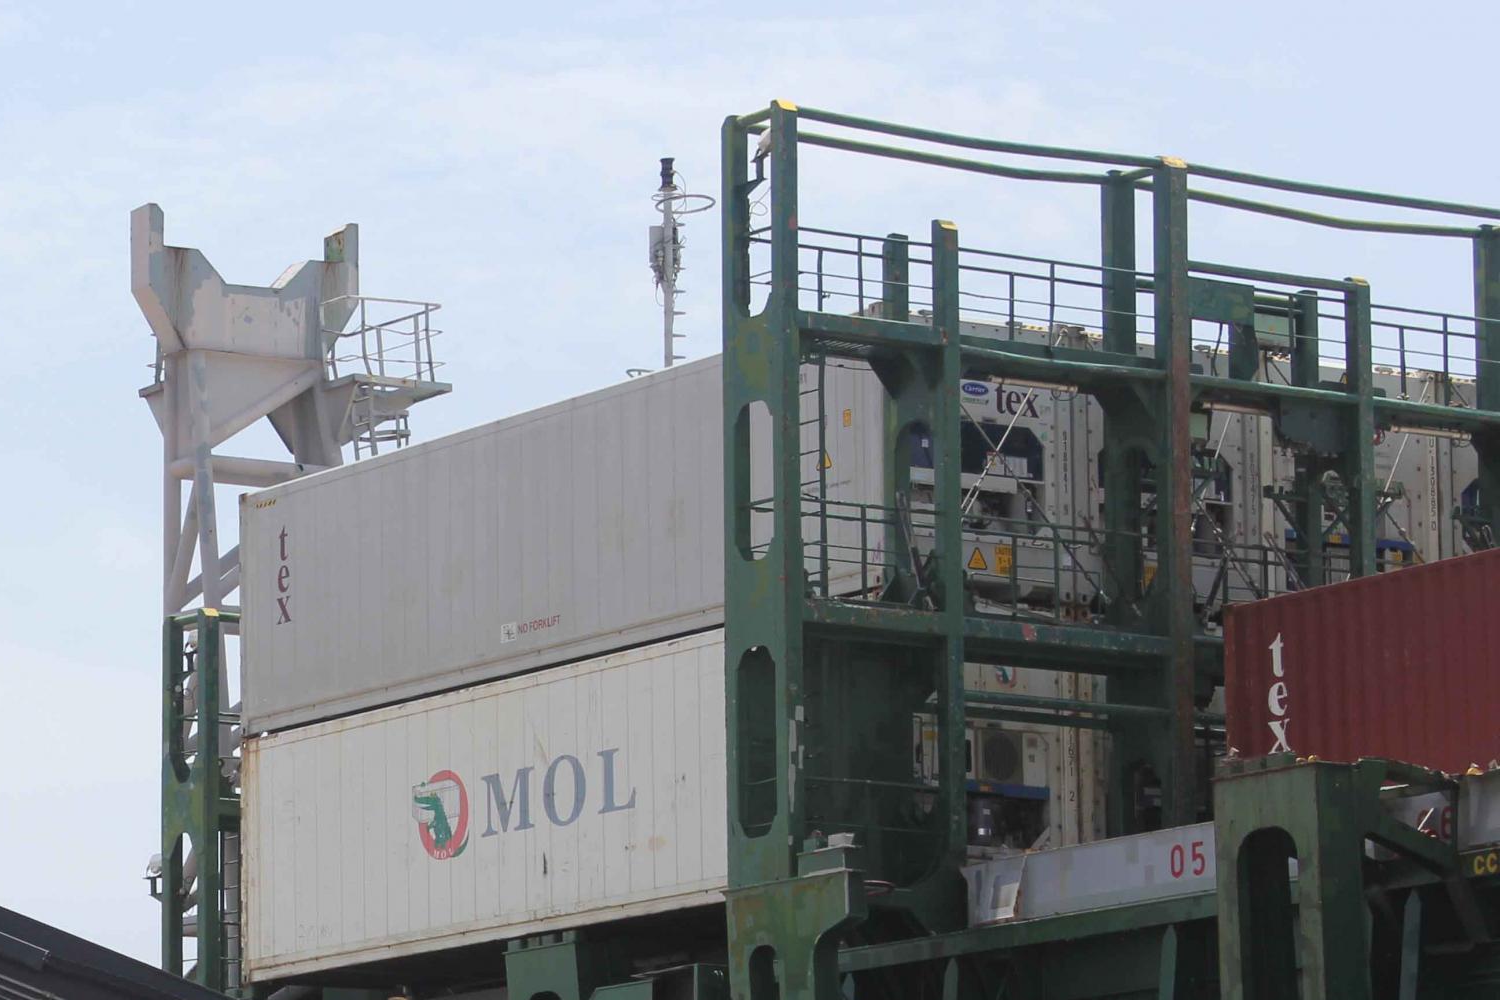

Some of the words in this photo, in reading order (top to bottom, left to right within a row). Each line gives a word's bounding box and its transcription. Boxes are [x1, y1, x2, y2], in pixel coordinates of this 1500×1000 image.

[995, 383, 1040, 419] tex
[277, 525, 291, 625] tex
[518, 623, 528, 634] NO
[529, 615, 560, 632] FORKLIFT
[1268, 632, 1291, 754] tex
[481, 749, 636, 838] MOL
